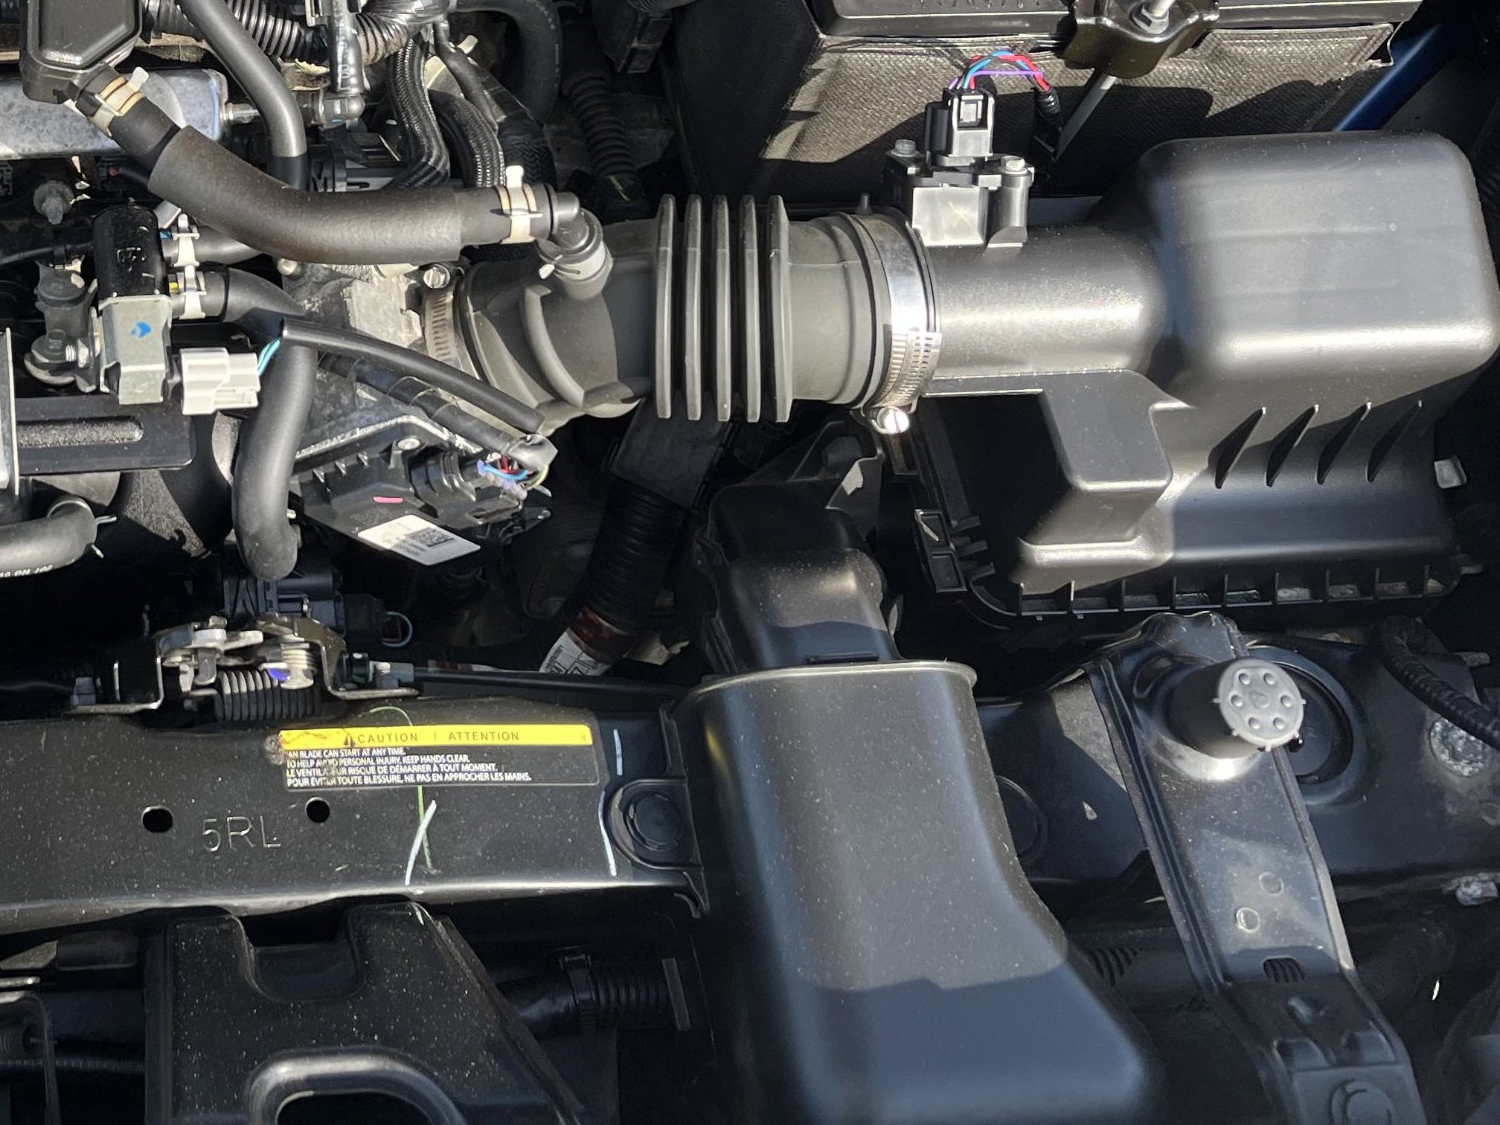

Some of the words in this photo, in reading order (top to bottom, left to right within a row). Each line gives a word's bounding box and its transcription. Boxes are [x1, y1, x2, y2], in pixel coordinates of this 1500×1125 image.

[357, 732, 419, 744] CAUTION
[448, 731, 520, 742] ATTENTION
[299, 749, 323, 758] BLADE
[323, 749, 339, 758] CAN
[339, 748, 361, 757] START
[361, 748, 371, 757] AT
[371, 747, 387, 756] ANY
[387, 747, 407, 756] TIME.
[286, 760, 297, 769] TO
[297, 759, 315, 768] HELP
[338, 757, 375, 767] PERSONAL
[402, 756, 420, 765] KEEP
[420, 755, 446, 764] HANDS
[446, 754, 471, 763] CLEAR.
[286, 769, 296, 778] LE
[347, 766, 377, 776] RISQUE
[377, 765, 388, 774] DE
[389, 764, 432, 774] DÉMARRER
[439, 763, 461, 773] TOUT
[461, 763, 498, 772] MOMENT.
[286, 777, 310, 787] POUR
[337, 775, 363, 785] TOUTE
[404, 773, 415, 783] NE
[416, 773, 431, 783] PAS
[431, 773, 443, 782] EN
[443, 772, 490, 782] APPROCHER
[490, 772, 504, 781] LES
[504, 772, 532, 781] MAINS.
[202, 815, 282, 852] 5RL
